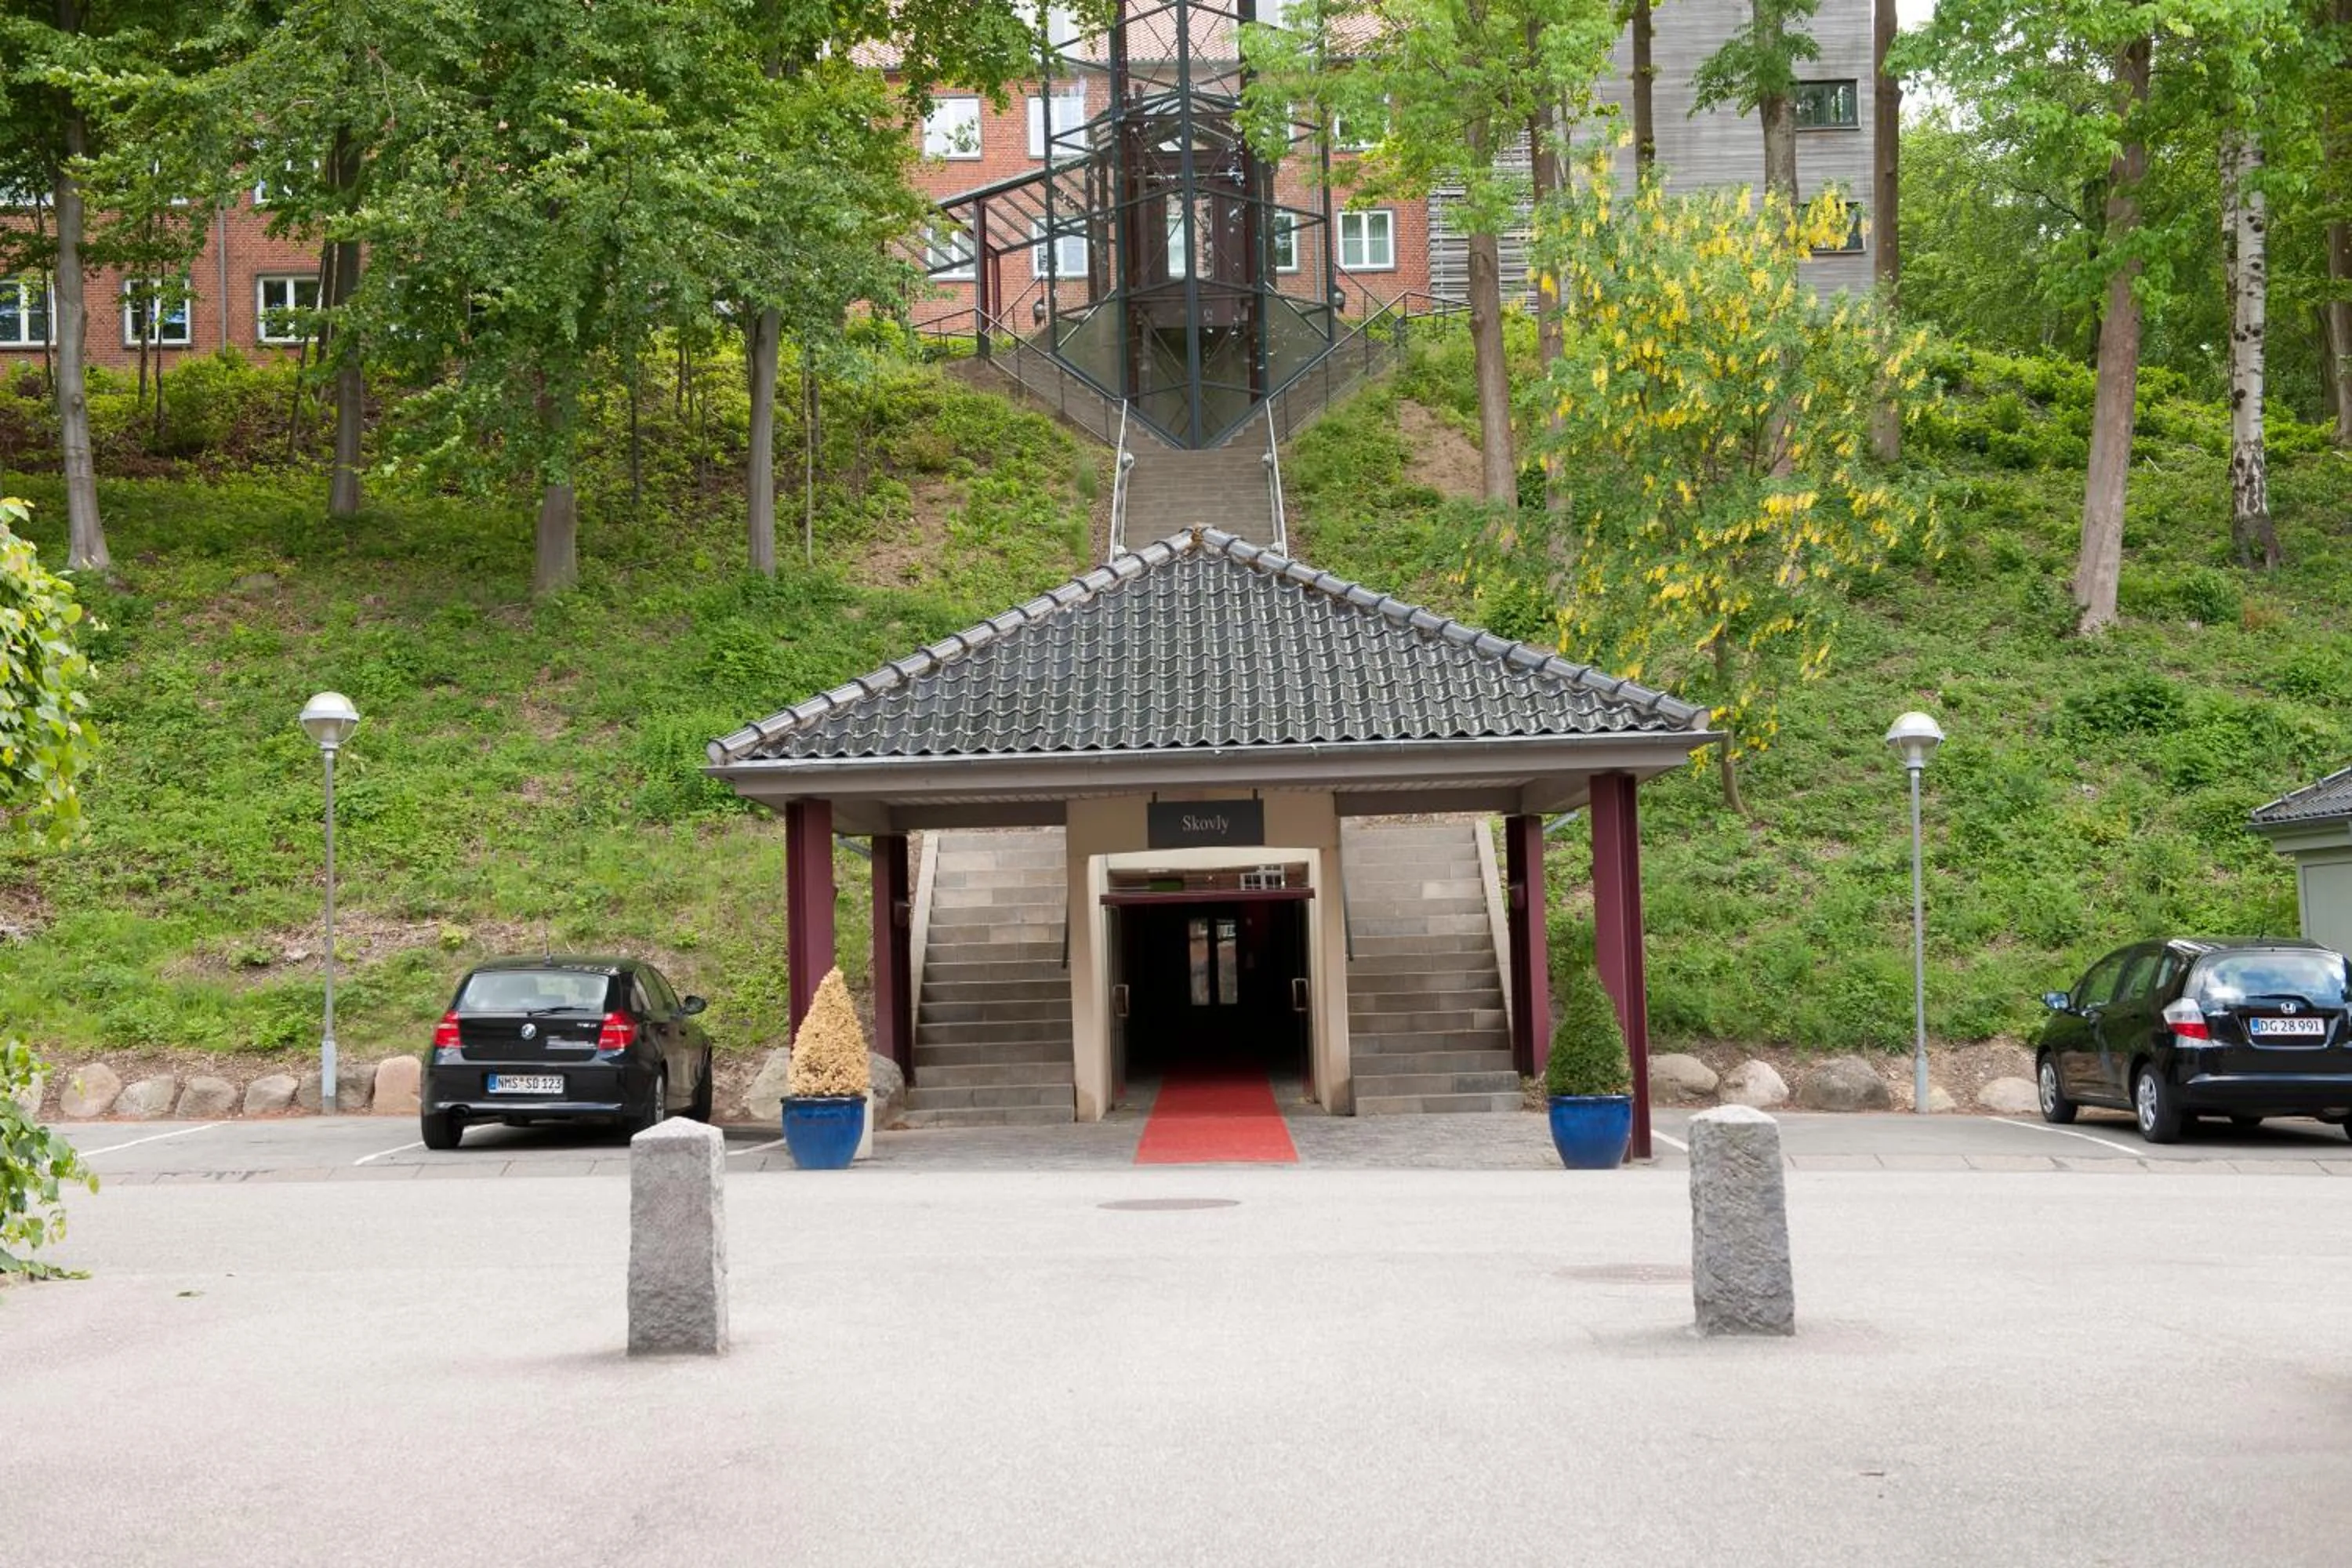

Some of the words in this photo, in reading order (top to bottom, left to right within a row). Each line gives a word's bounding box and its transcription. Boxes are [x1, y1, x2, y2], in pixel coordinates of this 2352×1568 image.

[1181, 815, 1229, 834] Skovly
[2260, 1020, 2278, 1032] DG
[2281, 1020, 2296, 1032] 28
[2298, 1020, 2321, 1032] 991
[498, 1077, 518, 1089] NMS
[542, 1077, 562, 1089] 123
